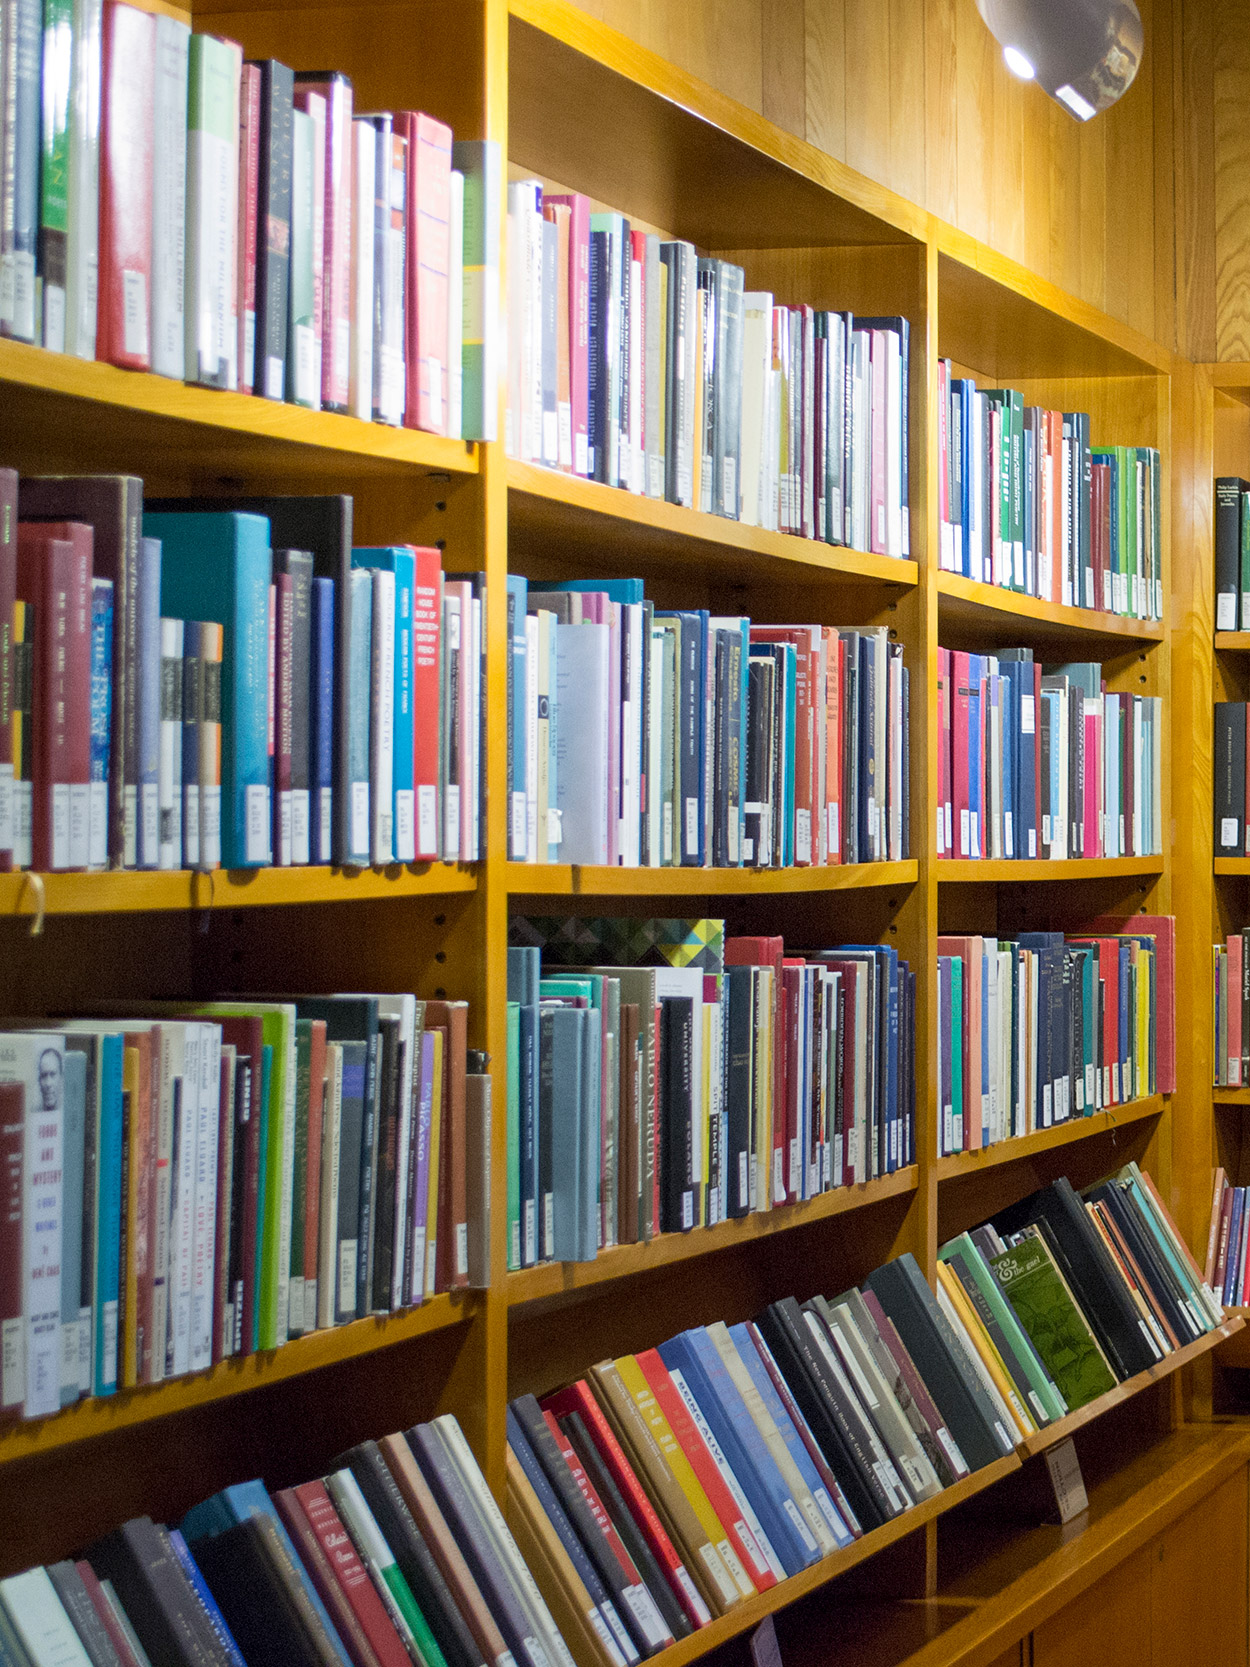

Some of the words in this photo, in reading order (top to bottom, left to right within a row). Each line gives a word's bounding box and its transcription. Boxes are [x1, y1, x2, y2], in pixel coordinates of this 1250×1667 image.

[219, 199, 228, 223] FOR
[218, 228, 227, 254] THE
[217, 260, 227, 352] MILLENNIUM
[130, 560, 138, 572] of
[129, 600, 137, 648] universe
[385, 587, 393, 637] MODERN
[96, 625, 106, 667] THE
[283, 637, 290, 651] BY
[384, 647, 393, 695] FRENCH
[383, 702, 391, 752] POETRY
[243, 1067, 251, 1120] GENET
[646, 1094, 654, 1179] NERUDA
[679, 1381, 702, 1423] BEING
[701, 1425, 724, 1465] ALIVE
[804, 1345, 813, 1360] The
[812, 1361, 821, 1377] New
[820, 1378, 839, 1411] Penguin
[838, 1412, 850, 1431] Book
[849, 1431, 855, 1440] of
[853, 1440, 872, 1474] English
[871, 1474, 885, 1498] Verse
[375, 1454, 420, 1539] OTHERWISE
